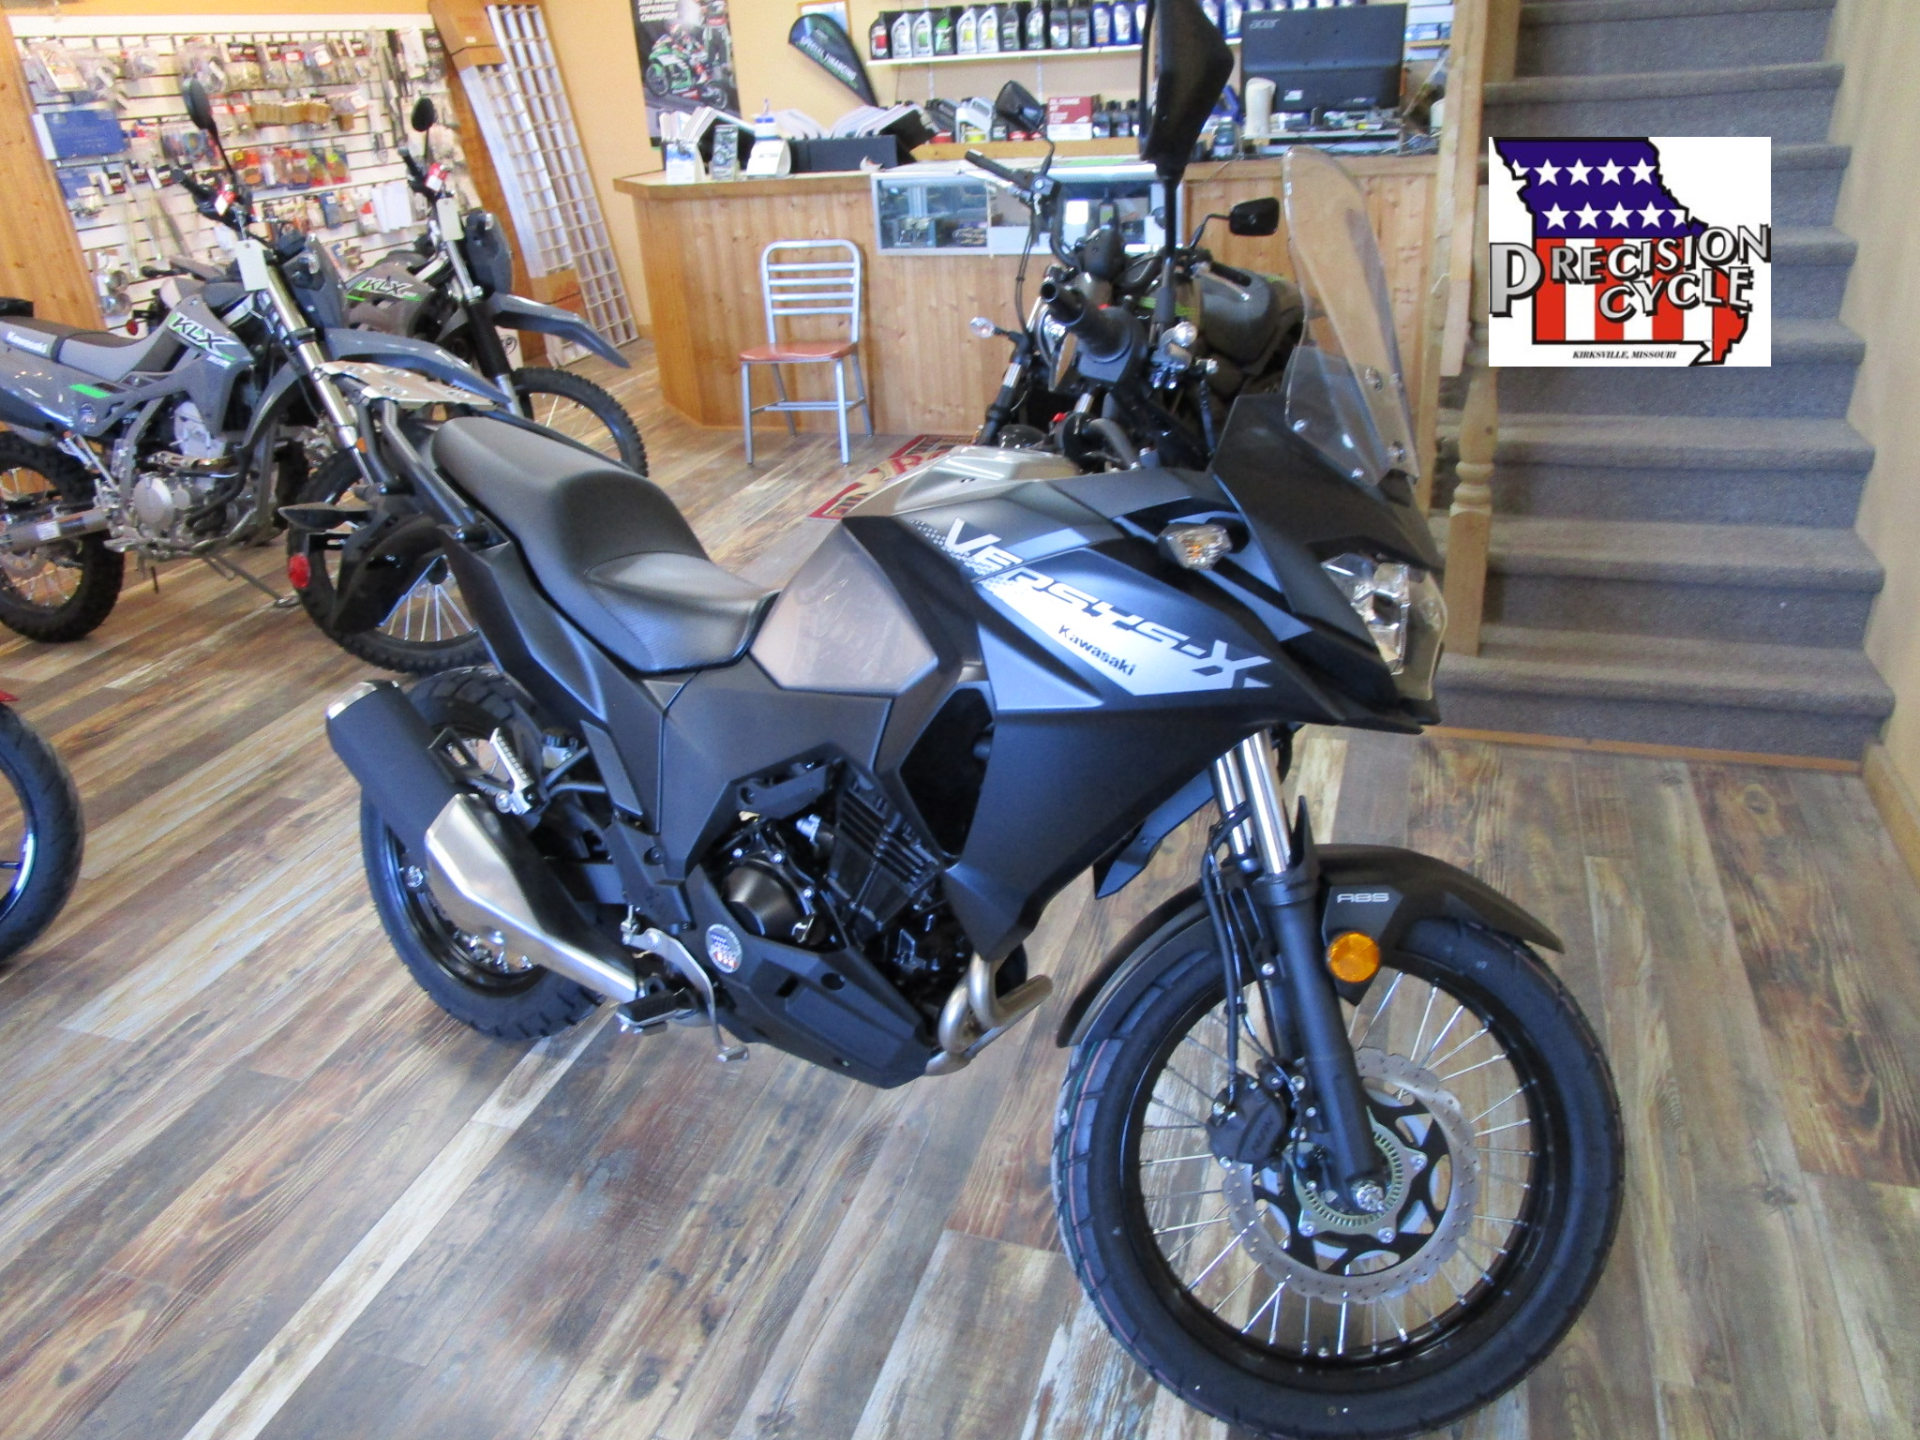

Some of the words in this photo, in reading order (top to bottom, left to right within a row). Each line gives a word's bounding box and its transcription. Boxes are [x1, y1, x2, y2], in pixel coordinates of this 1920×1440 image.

[1249, 18, 1280, 30] acer
[824, 53, 857, 81] FINANCING
[361, 277, 414, 298] KLX
[168, 312, 239, 357] KLX
[1058, 624, 1137, 677] Kawasaki
[1336, 892, 1390, 903] ABS
